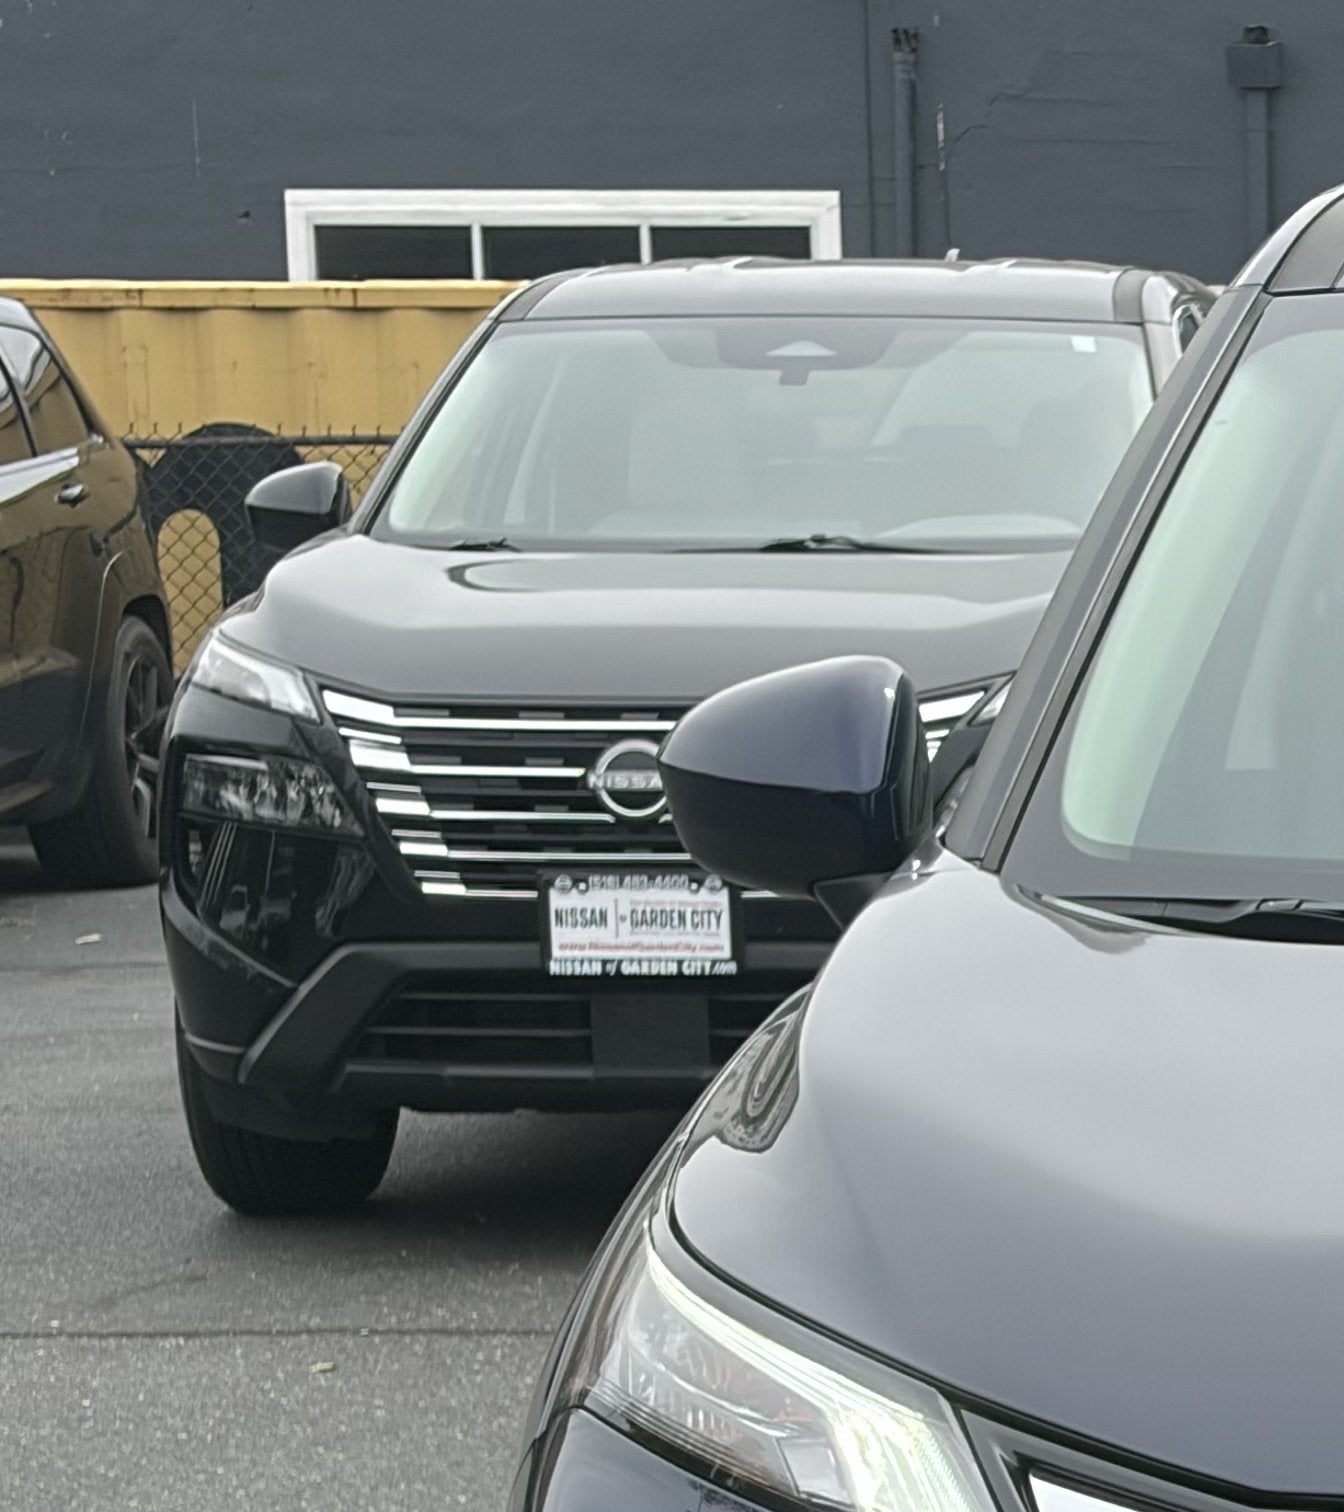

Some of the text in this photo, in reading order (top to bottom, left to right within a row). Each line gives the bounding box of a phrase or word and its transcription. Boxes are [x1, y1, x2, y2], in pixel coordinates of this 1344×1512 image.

[588, 773, 663, 789] NISSA
[555, 908, 607, 928] NISSAN
[630, 908, 686, 929] GARDEN
[691, 909, 722, 930] CITY
[550, 959, 602, 975] NISSAN
[620, 960, 678, 975] GARDEN
